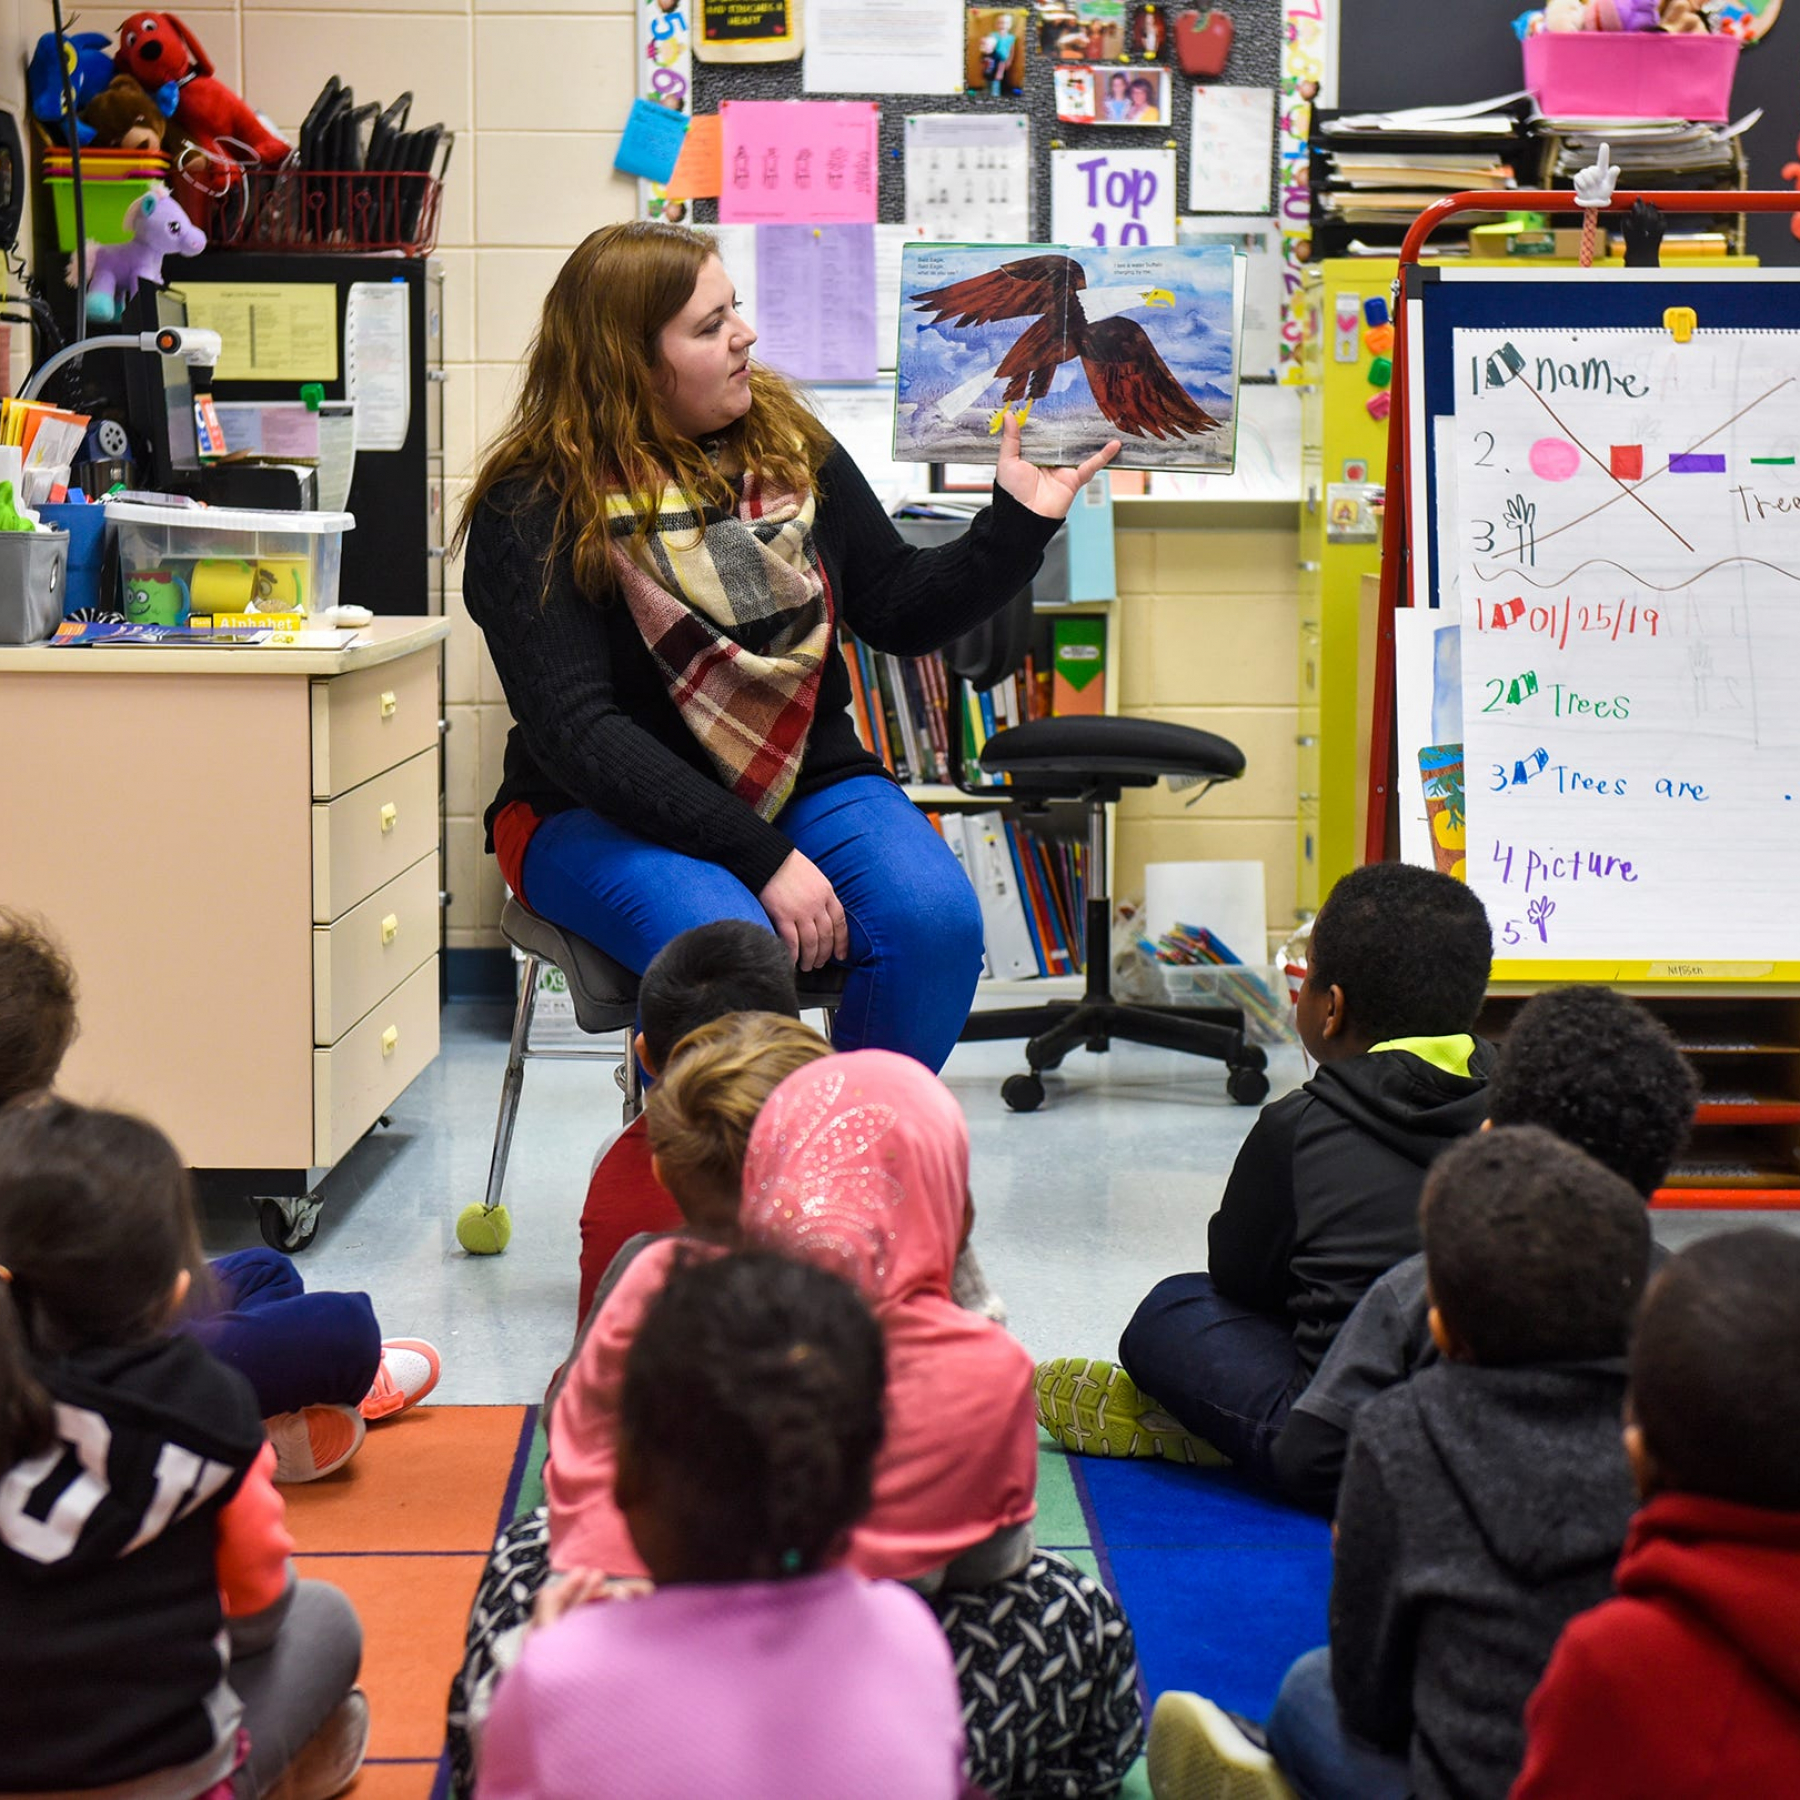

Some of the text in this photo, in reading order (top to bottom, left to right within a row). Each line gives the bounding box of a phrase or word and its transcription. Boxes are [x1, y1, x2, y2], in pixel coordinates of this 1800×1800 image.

[651, 12, 686, 40] 5
[1077, 157, 1157, 219] Top
[1536, 357, 1649, 398] name
[1530, 595, 1659, 650] 01/25/19
[1547, 684, 1630, 719] Trees
[1551, 766, 1627, 795] Trees
[1655, 778, 1709, 801] are
[1525, 846, 1638, 893] picture
